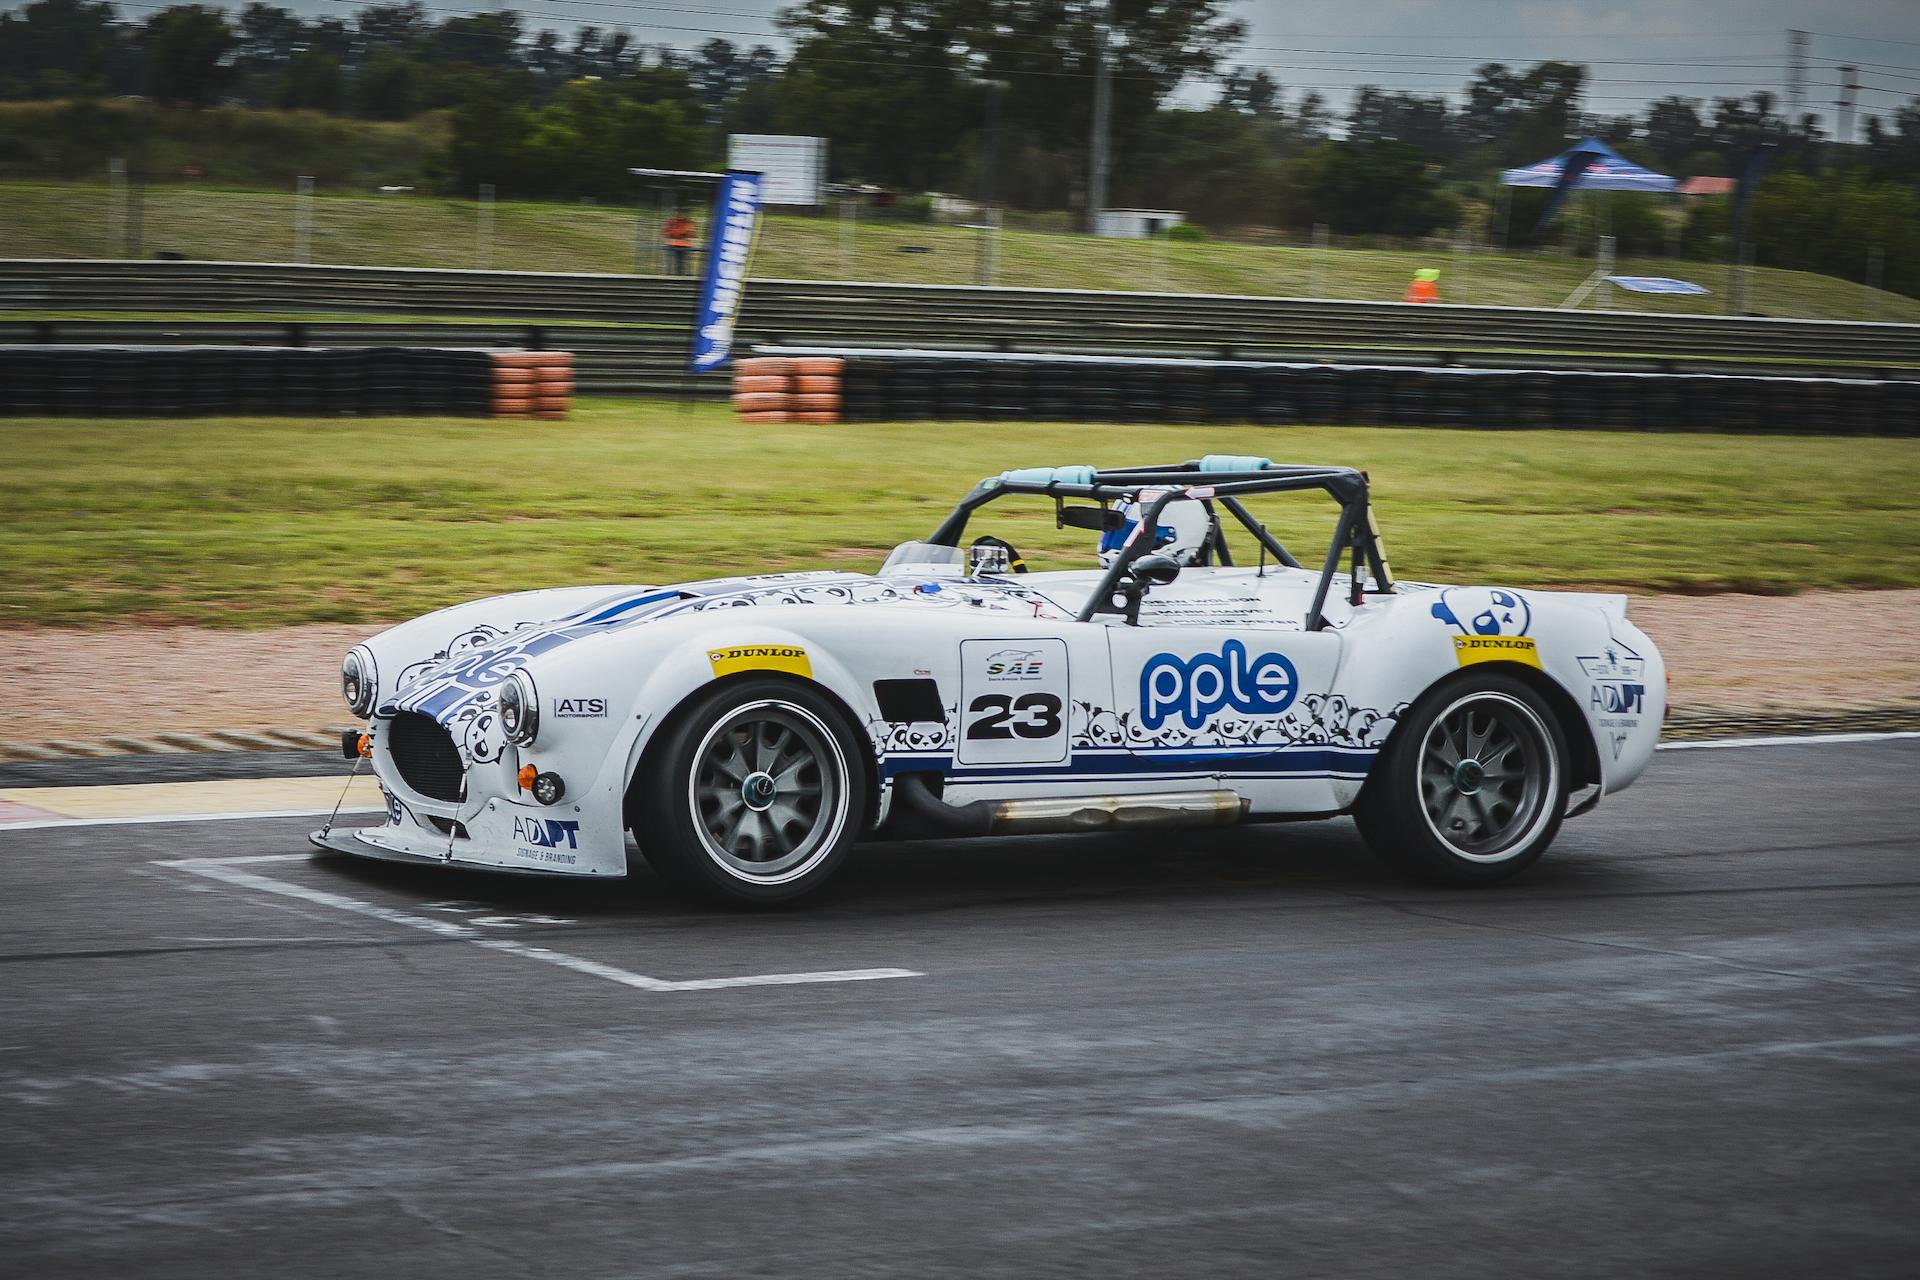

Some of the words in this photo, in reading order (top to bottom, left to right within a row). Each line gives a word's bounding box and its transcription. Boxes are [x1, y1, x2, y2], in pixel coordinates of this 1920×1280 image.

[1469, 640, 1535, 650] DUNLOP
[728, 648, 805, 659] DUNLOP
[986, 662, 1043, 675] SAE
[1146, 646, 1292, 721] pple
[558, 698, 604, 713] ATS
[1591, 685, 1645, 714] ADAPT
[967, 692, 1062, 740] 23
[513, 815, 580, 850] ADAPT
[545, 852, 577, 865] BRANDING
